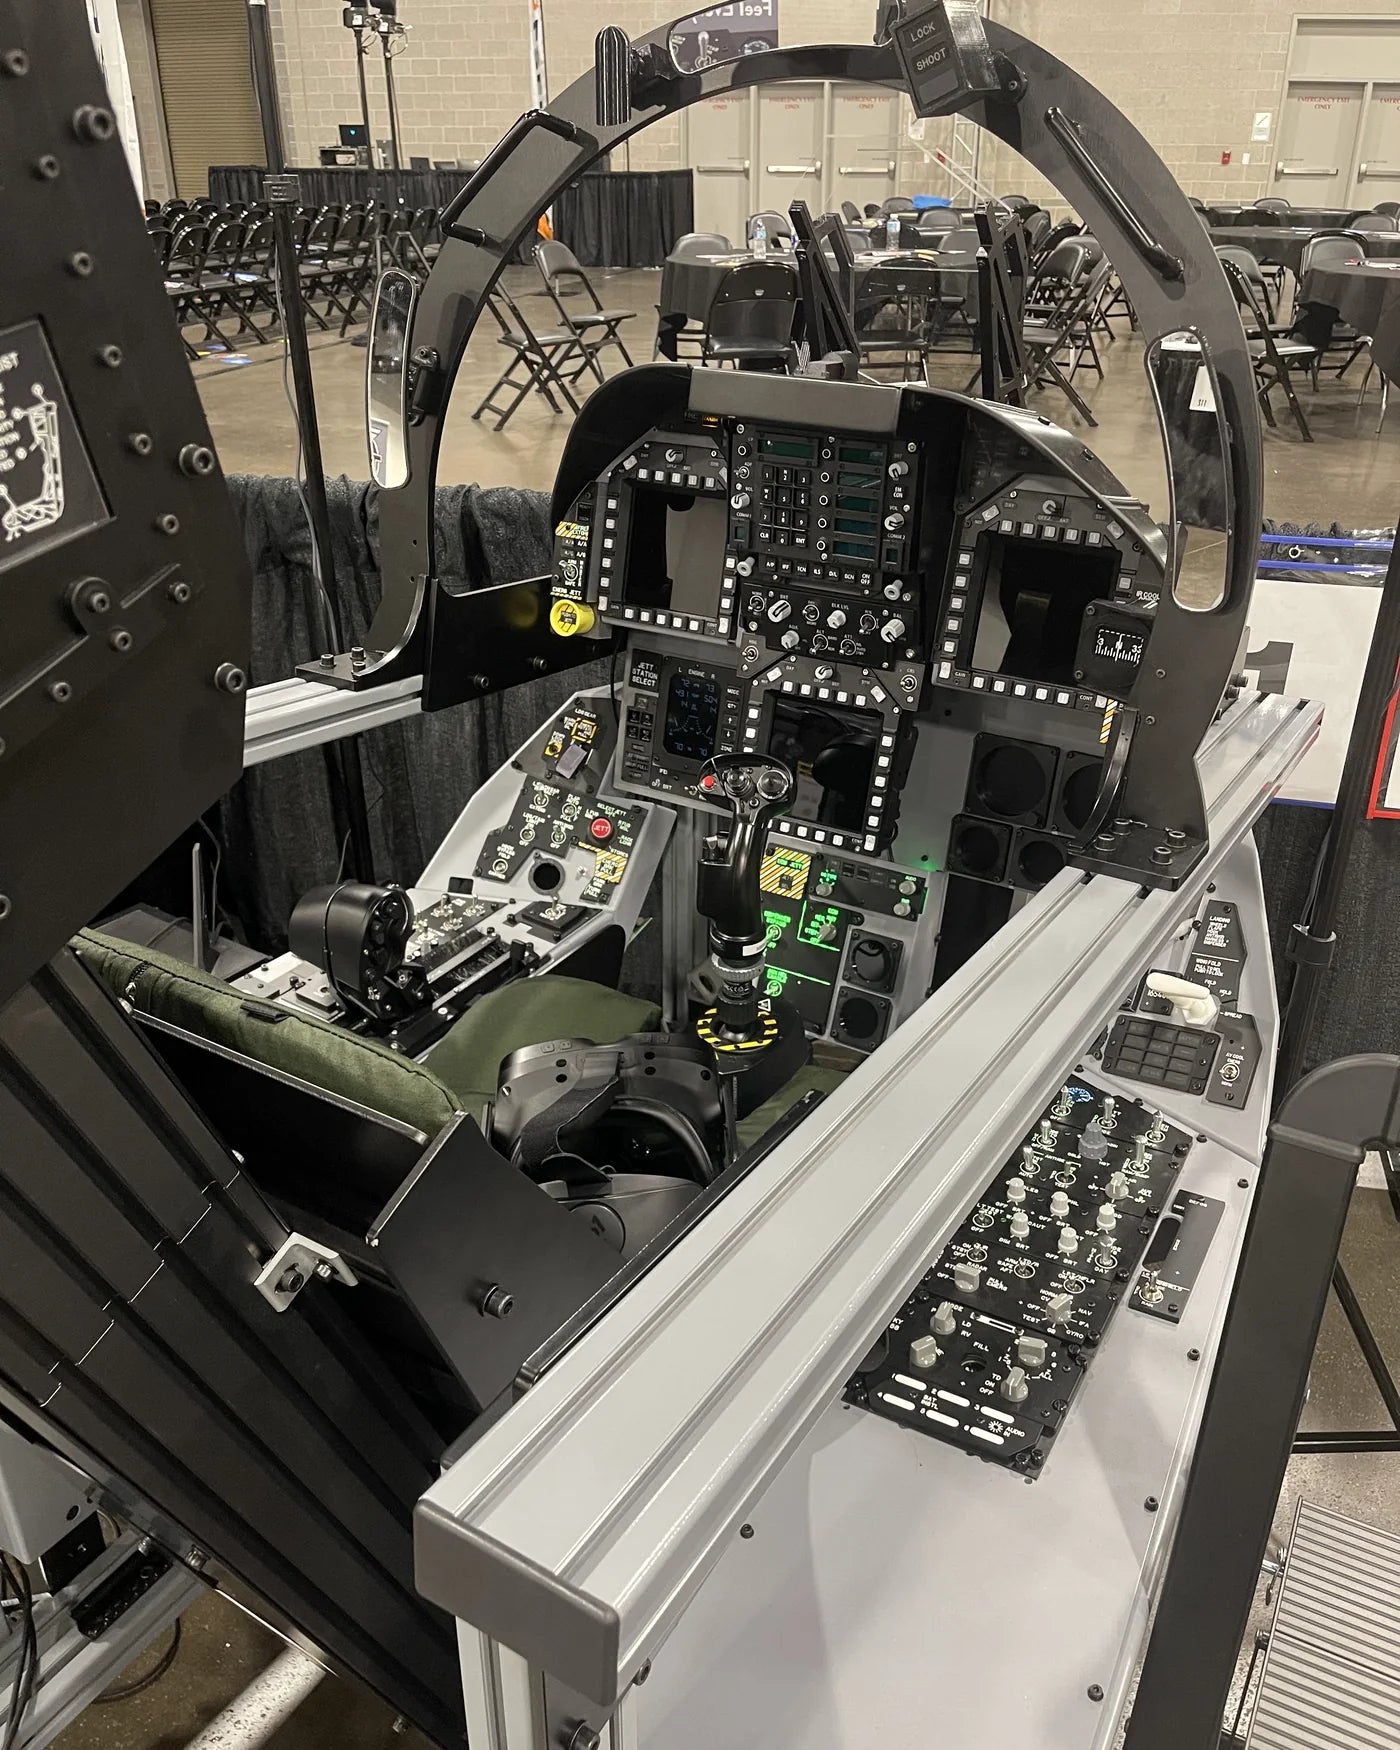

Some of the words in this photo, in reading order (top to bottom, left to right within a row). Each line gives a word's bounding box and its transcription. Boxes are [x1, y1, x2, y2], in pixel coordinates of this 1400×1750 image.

[910, 22, 936, 42] LOCK
[916, 48, 946, 71] SHOOT
[552, 586, 568, 594] EMERG
[1144, 592, 1160, 600] COOL
[1097, 638, 1105, 646] 3
[638, 662, 654, 671] JETT
[632, 668, 658, 680] STATION
[688, 668, 705, 678] ENGINE
[632, 675, 656, 687] SELECT
[681, 678, 690, 686] 72
[705, 683, 715, 693] 73
[1080, 694, 1093, 702] CONT
[675, 742, 684, 751] 70
[699, 747, 708, 757] 70
[721, 744, 733, 753] ZONE
[1210, 916, 1231, 924] LANDING
[1196, 958, 1208, 966] WING
[1224, 1011, 1243, 1020] SPREAD
[1028, 1221, 1046, 1230] CAUT
[998, 1237, 1011, 1245] DIM
[1016, 1242, 1030, 1251] BRT
[953, 1250, 966, 1258] OFF
[997, 1260, 1014, 1269] SAFE
[1005, 1257, 1019, 1265] ARM
[966, 1262, 988, 1272] RADAR
[1094, 1266, 1109, 1274] DAY
[937, 1272, 950, 1280] OFF
[1027, 1303, 1041, 1311] OFF
[1078, 1308, 1093, 1317] NAV
[892, 1317, 904, 1325] KY
[1022, 1313, 1041, 1324] TEST
[962, 1320, 972, 1328] LD
[960, 1330, 972, 1338] RV
[1066, 1330, 1084, 1339] GYRO
[973, 1341, 990, 1352] FILL
[992, 1373, 1002, 1381] TD
[985, 1380, 996, 1388] ON
[979, 1387, 995, 1396] OFF
[923, 1394, 937, 1404] BAT
[921, 1399, 939, 1410] INSTL
[1005, 1427, 1026, 1438] AUDIO
